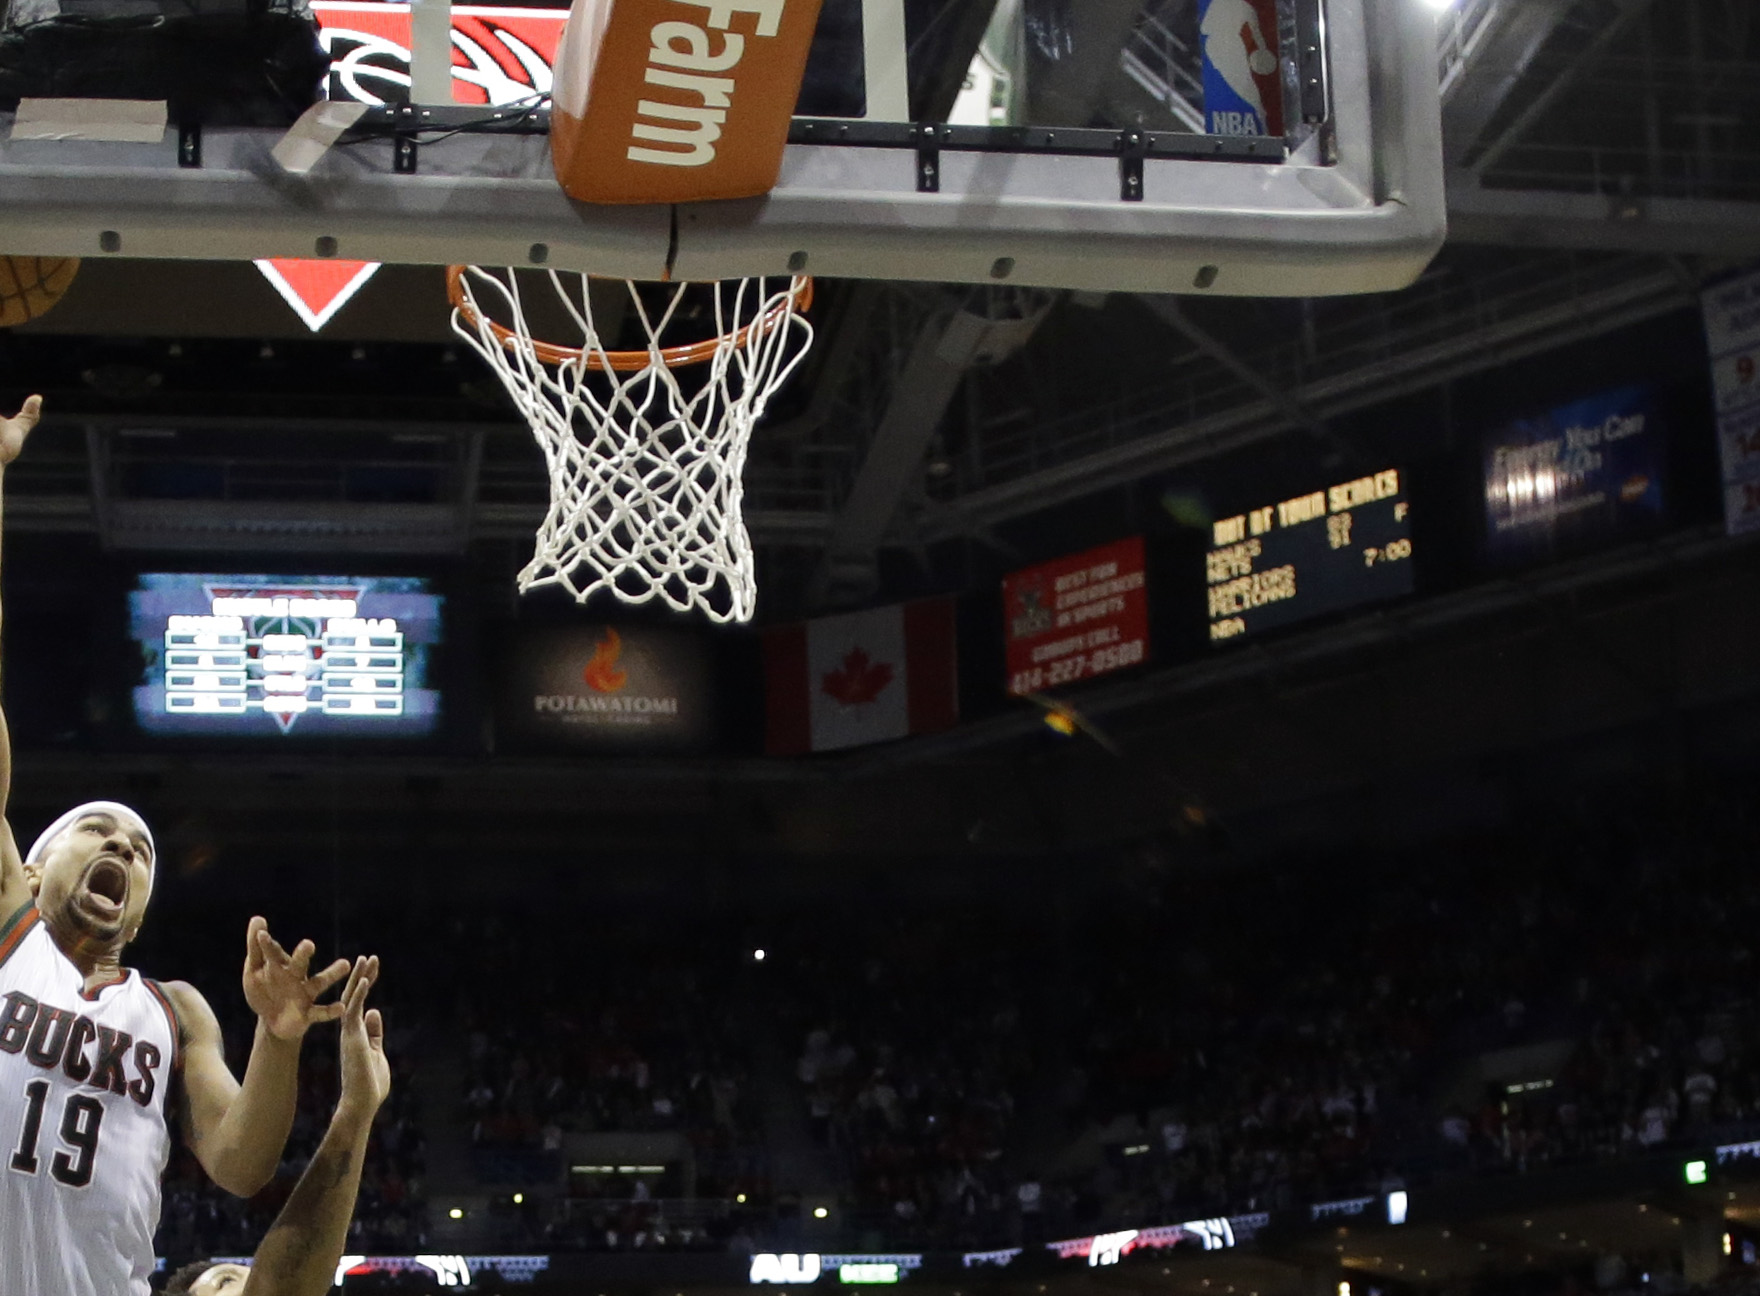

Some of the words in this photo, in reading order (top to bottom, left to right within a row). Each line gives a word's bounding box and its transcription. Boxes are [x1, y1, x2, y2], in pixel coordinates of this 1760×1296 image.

[627, 0, 786, 167] Farm
[1211, 110, 1259, 135] NBA
[534, 695, 678, 714] POTAWATOMI
[8, 1077, 105, 1190] 19
